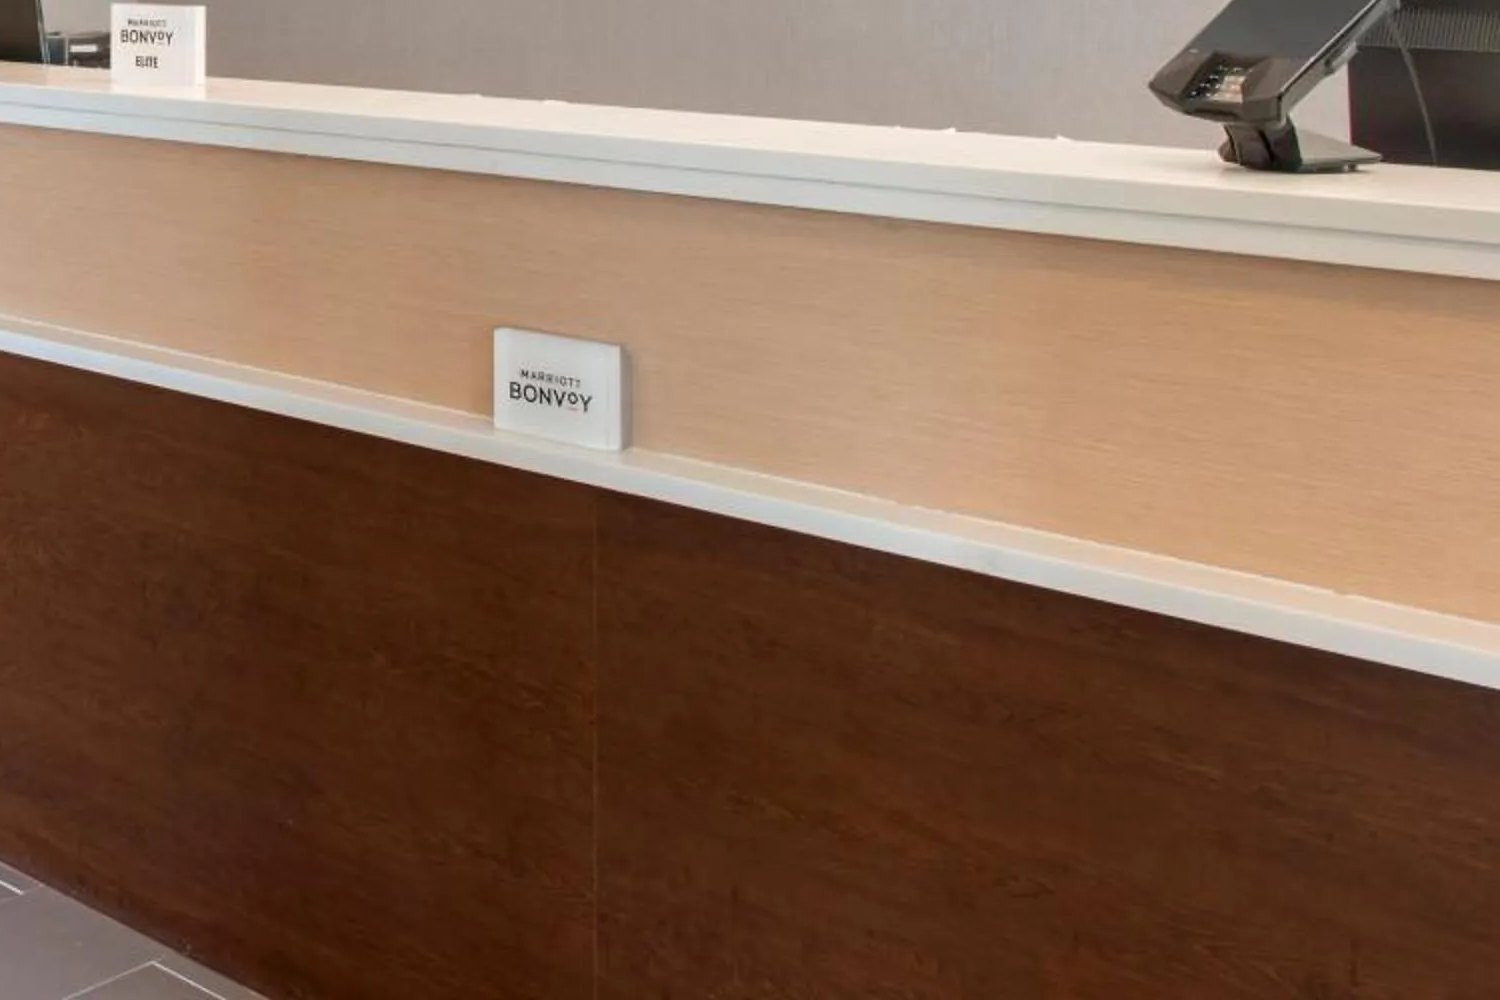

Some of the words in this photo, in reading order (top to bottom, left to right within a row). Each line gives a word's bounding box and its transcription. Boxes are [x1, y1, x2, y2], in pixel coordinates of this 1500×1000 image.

[120, 29, 173, 46] BONVOY
[135, 55, 159, 68] ELITE
[520, 369, 581, 388] MARRIOTT
[509, 381, 592, 413] BONVOY
